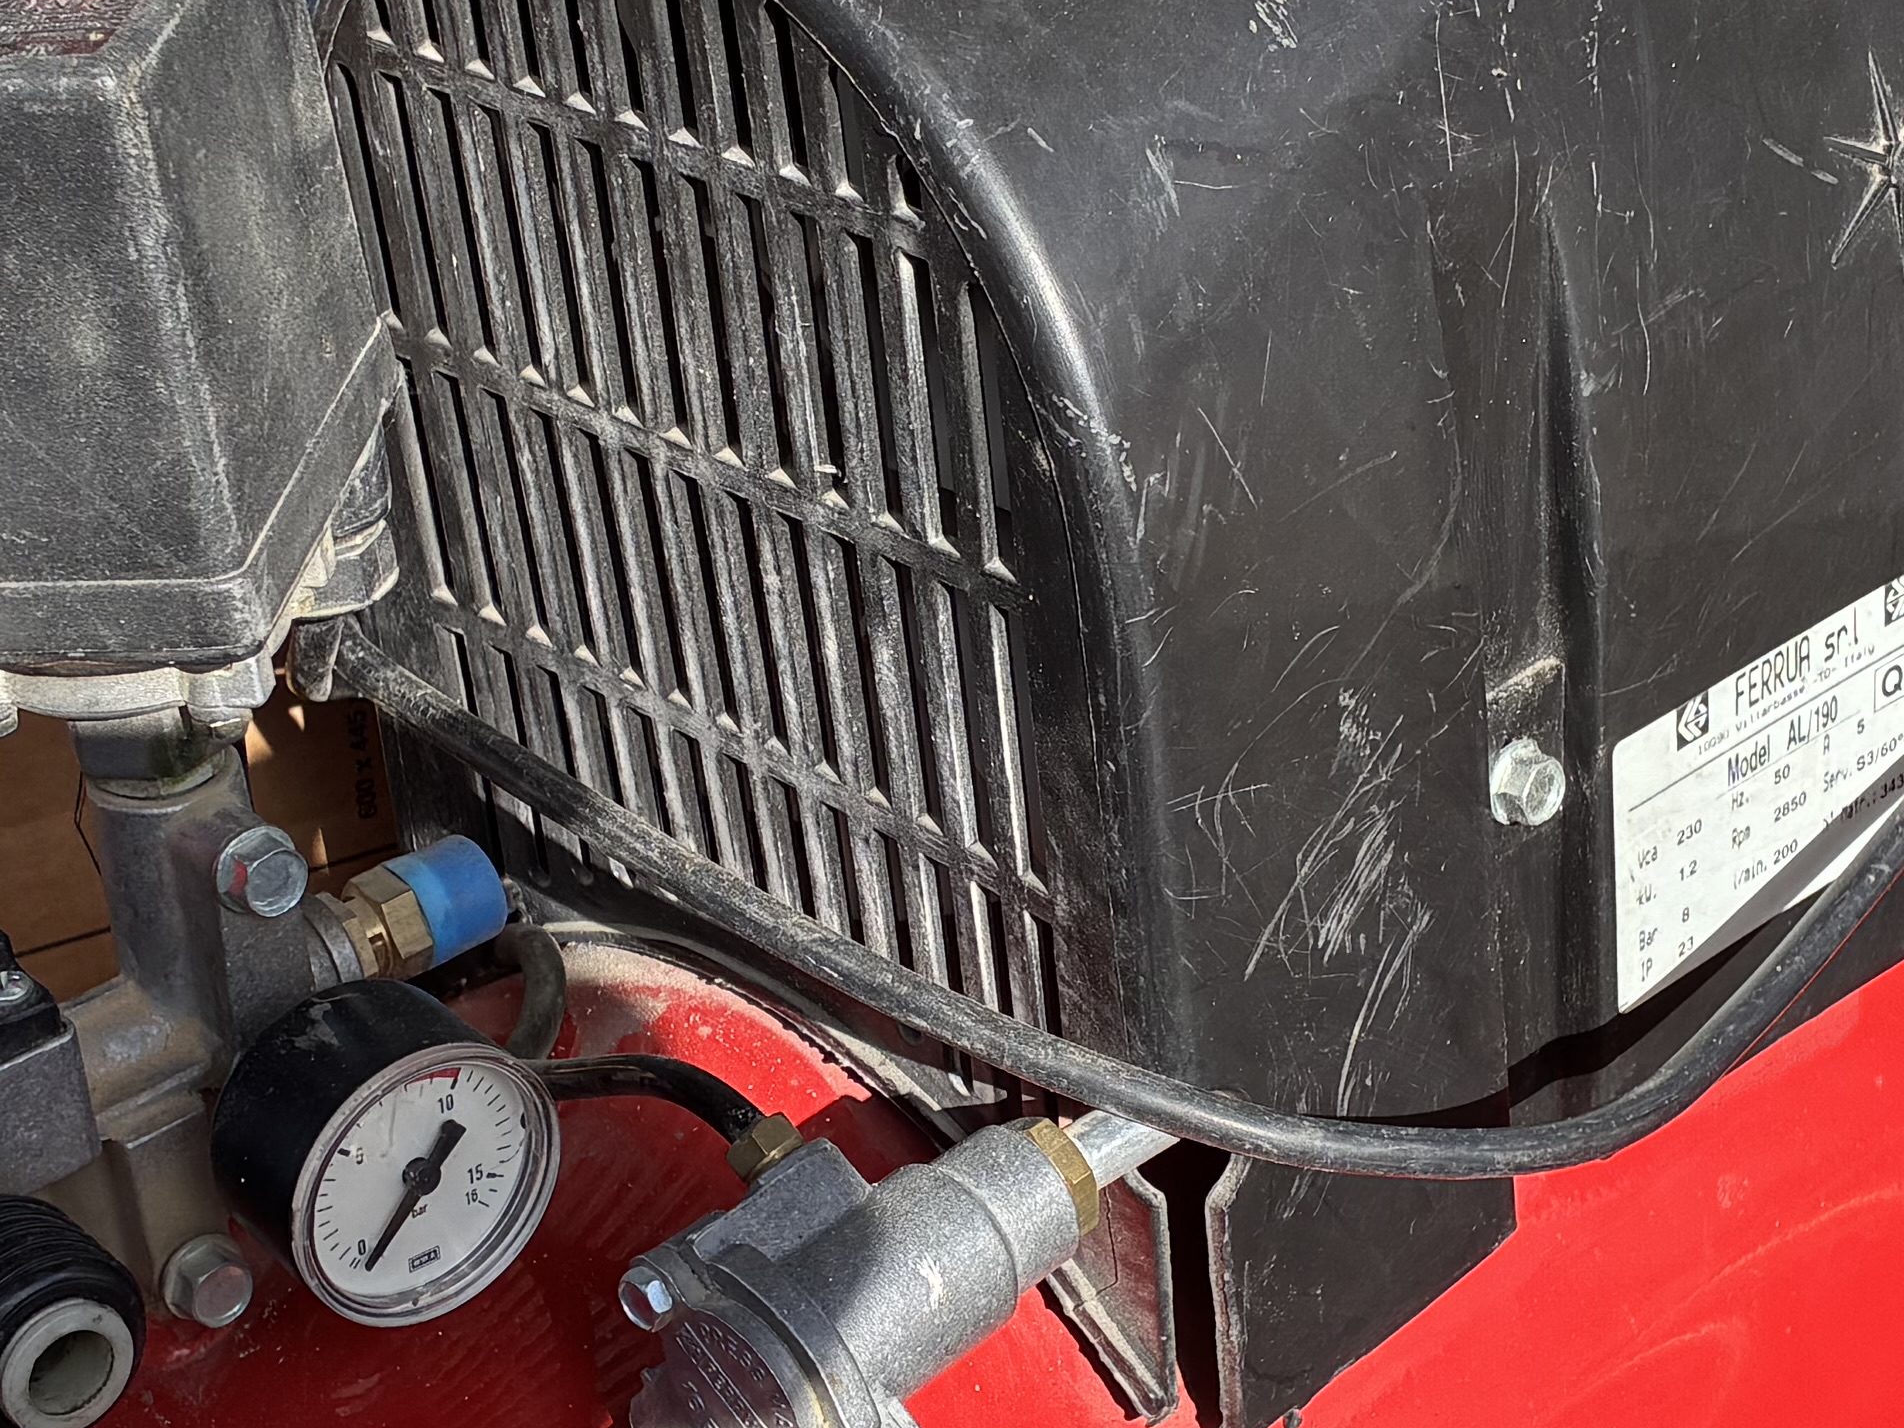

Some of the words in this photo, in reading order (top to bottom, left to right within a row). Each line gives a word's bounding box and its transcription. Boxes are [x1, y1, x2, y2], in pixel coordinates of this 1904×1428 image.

[1736, 636, 1810, 716] FERRUA
[1727, 735, 1770, 787] Model
[1787, 695, 1838, 751] AL/190
[1677, 819, 1703, 846] 230
[1774, 764, 1790, 786] 50
[1856, 718, 1865, 736] 5
[1773, 791, 1807, 823] 2850
[1681, 906, 1690, 923] 8
[1773, 839, 1798, 865] 200
[1678, 935, 1694, 959] 23
[438, 1094, 455, 1115] 10
[354, 1147, 365, 1165] 5
[467, 1164, 484, 1184] 15
[356, 1239, 367, 1256] 0
